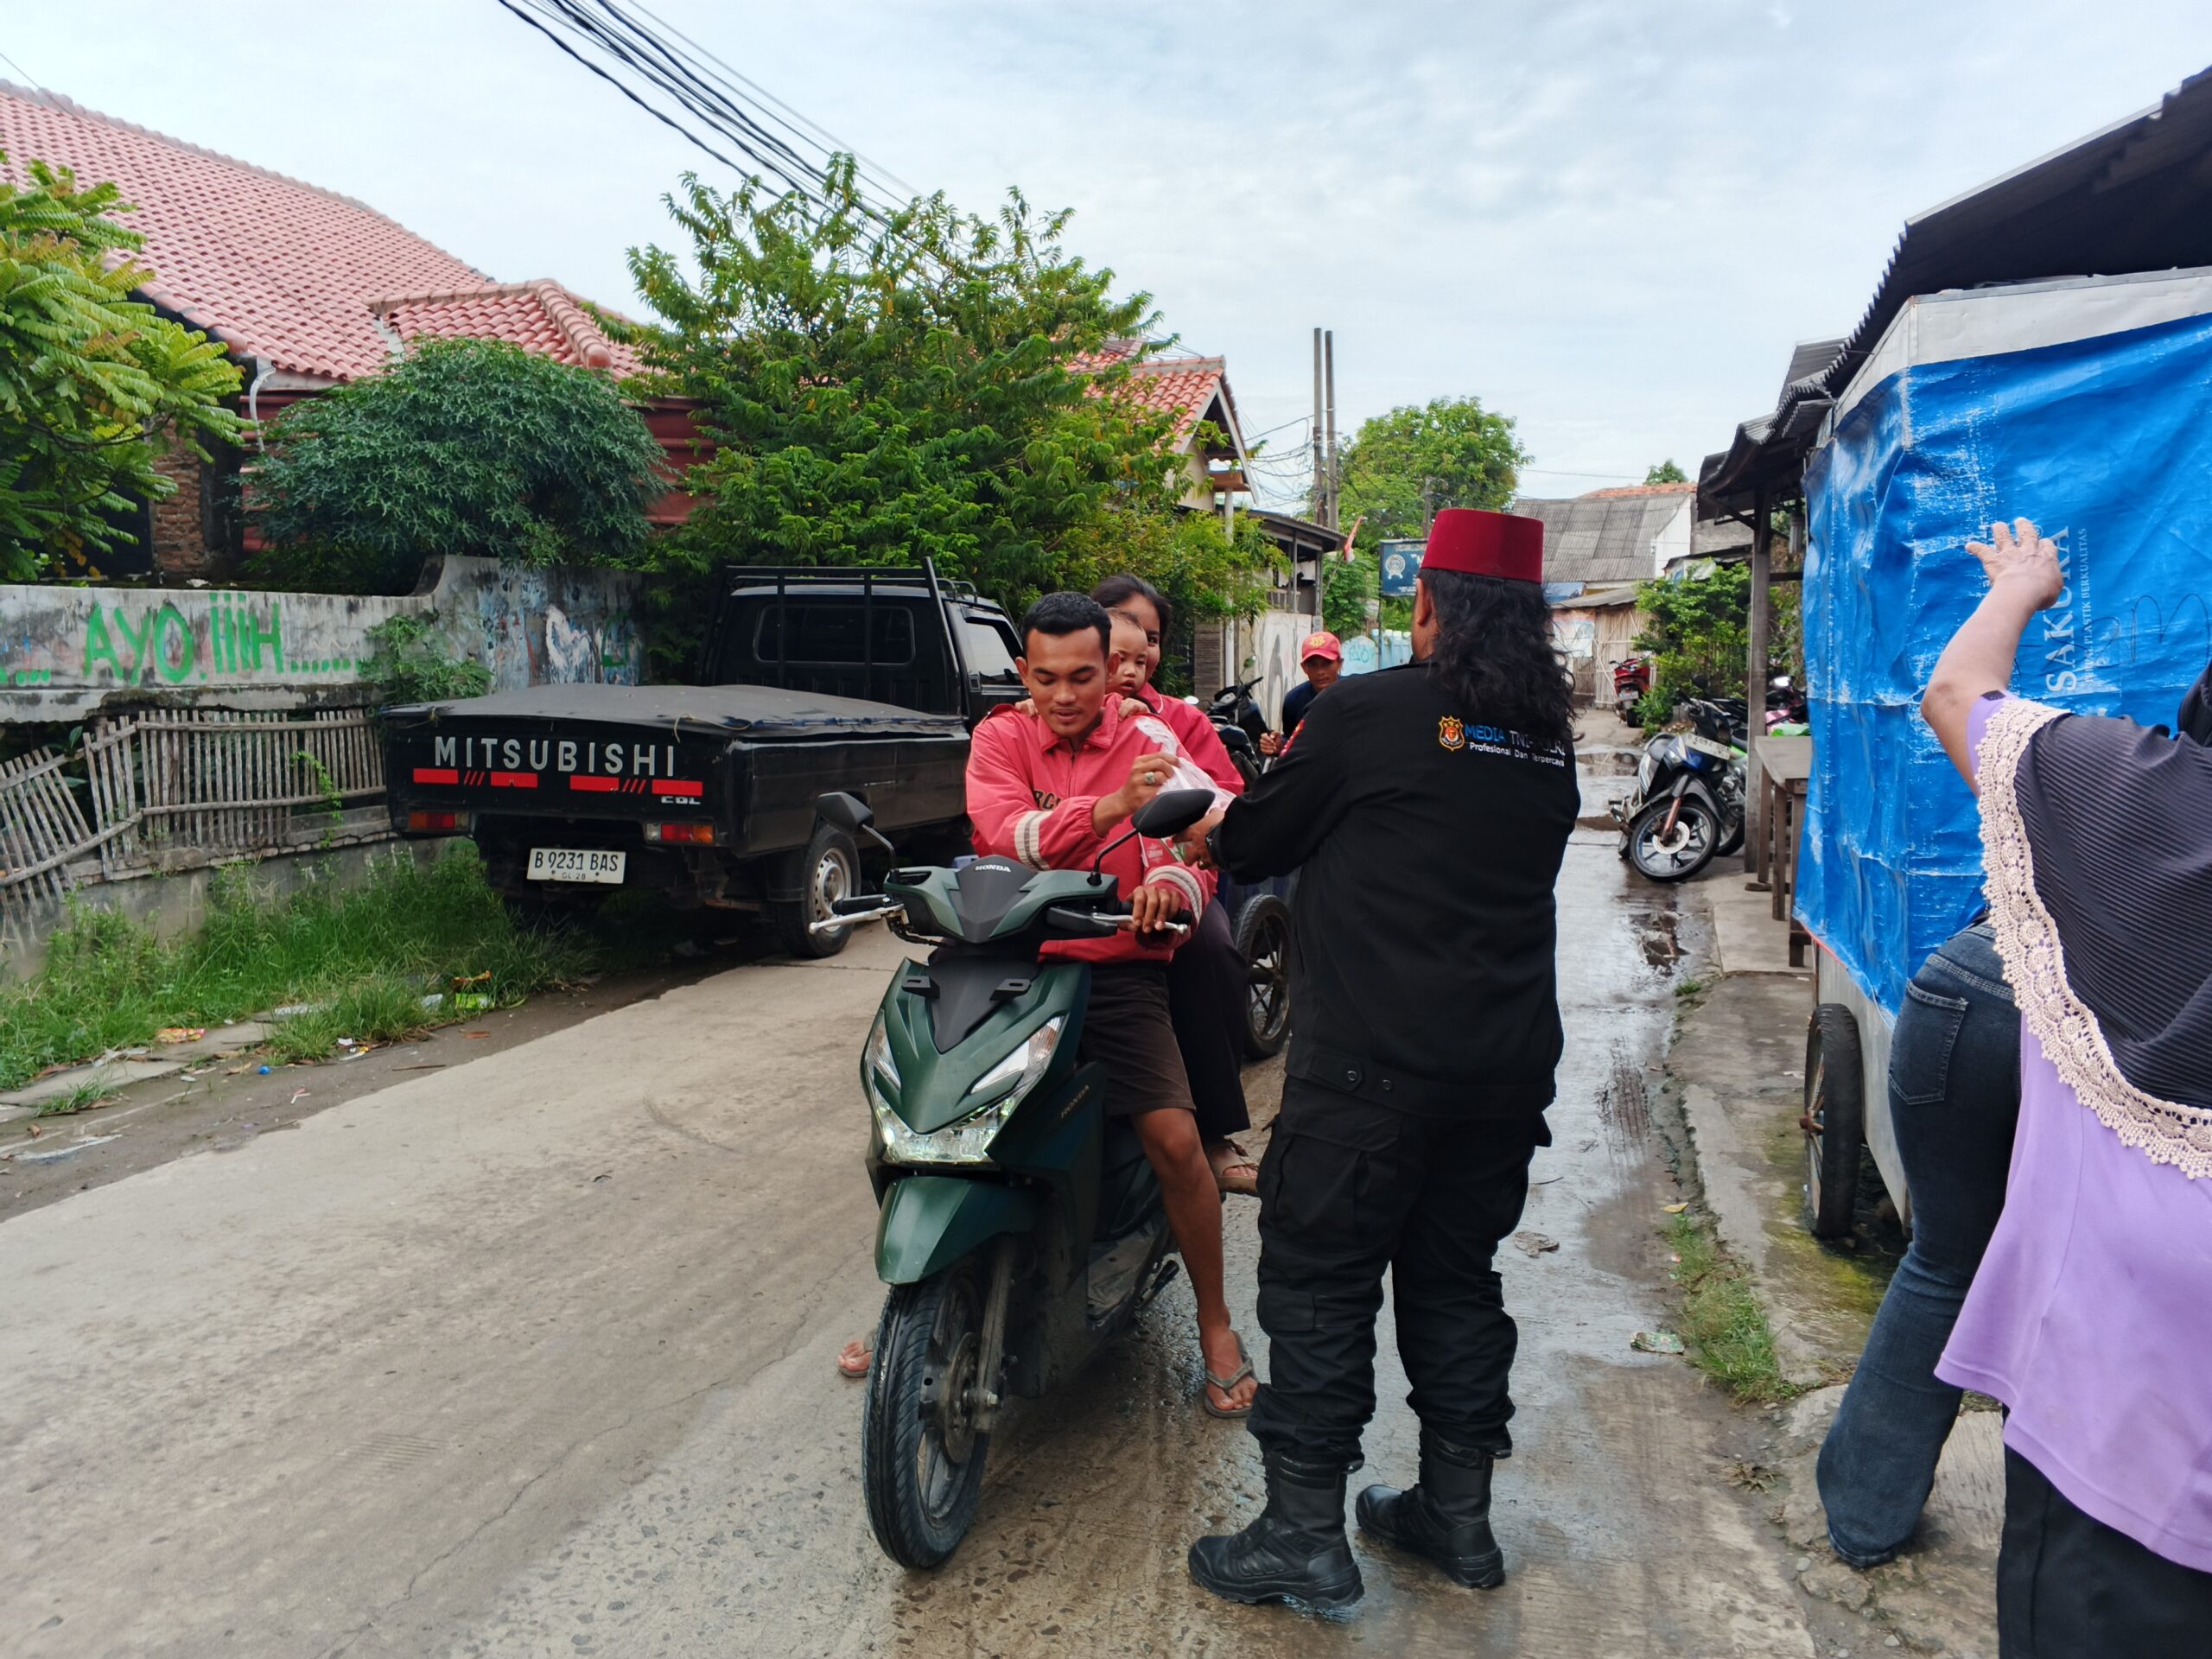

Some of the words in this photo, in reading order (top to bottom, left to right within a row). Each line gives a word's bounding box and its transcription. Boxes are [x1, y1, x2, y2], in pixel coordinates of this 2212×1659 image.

[2077, 528, 2091, 598] BERKUALITAS
[2082, 601, 2093, 644] PLASTIK
[1465, 723, 1506, 743] MEDIA
[435, 736, 674, 777] MITSUBISHI
[1470, 741, 1511, 756] Profesional
[1515, 749, 1528, 760] Dan
[1531, 753, 1565, 767] Terpercaya
[535, 852, 543, 868] B
[548, 852, 584, 870] 9231
[590, 854, 619, 871] BAS
[975, 864, 1012, 873] HONDA
